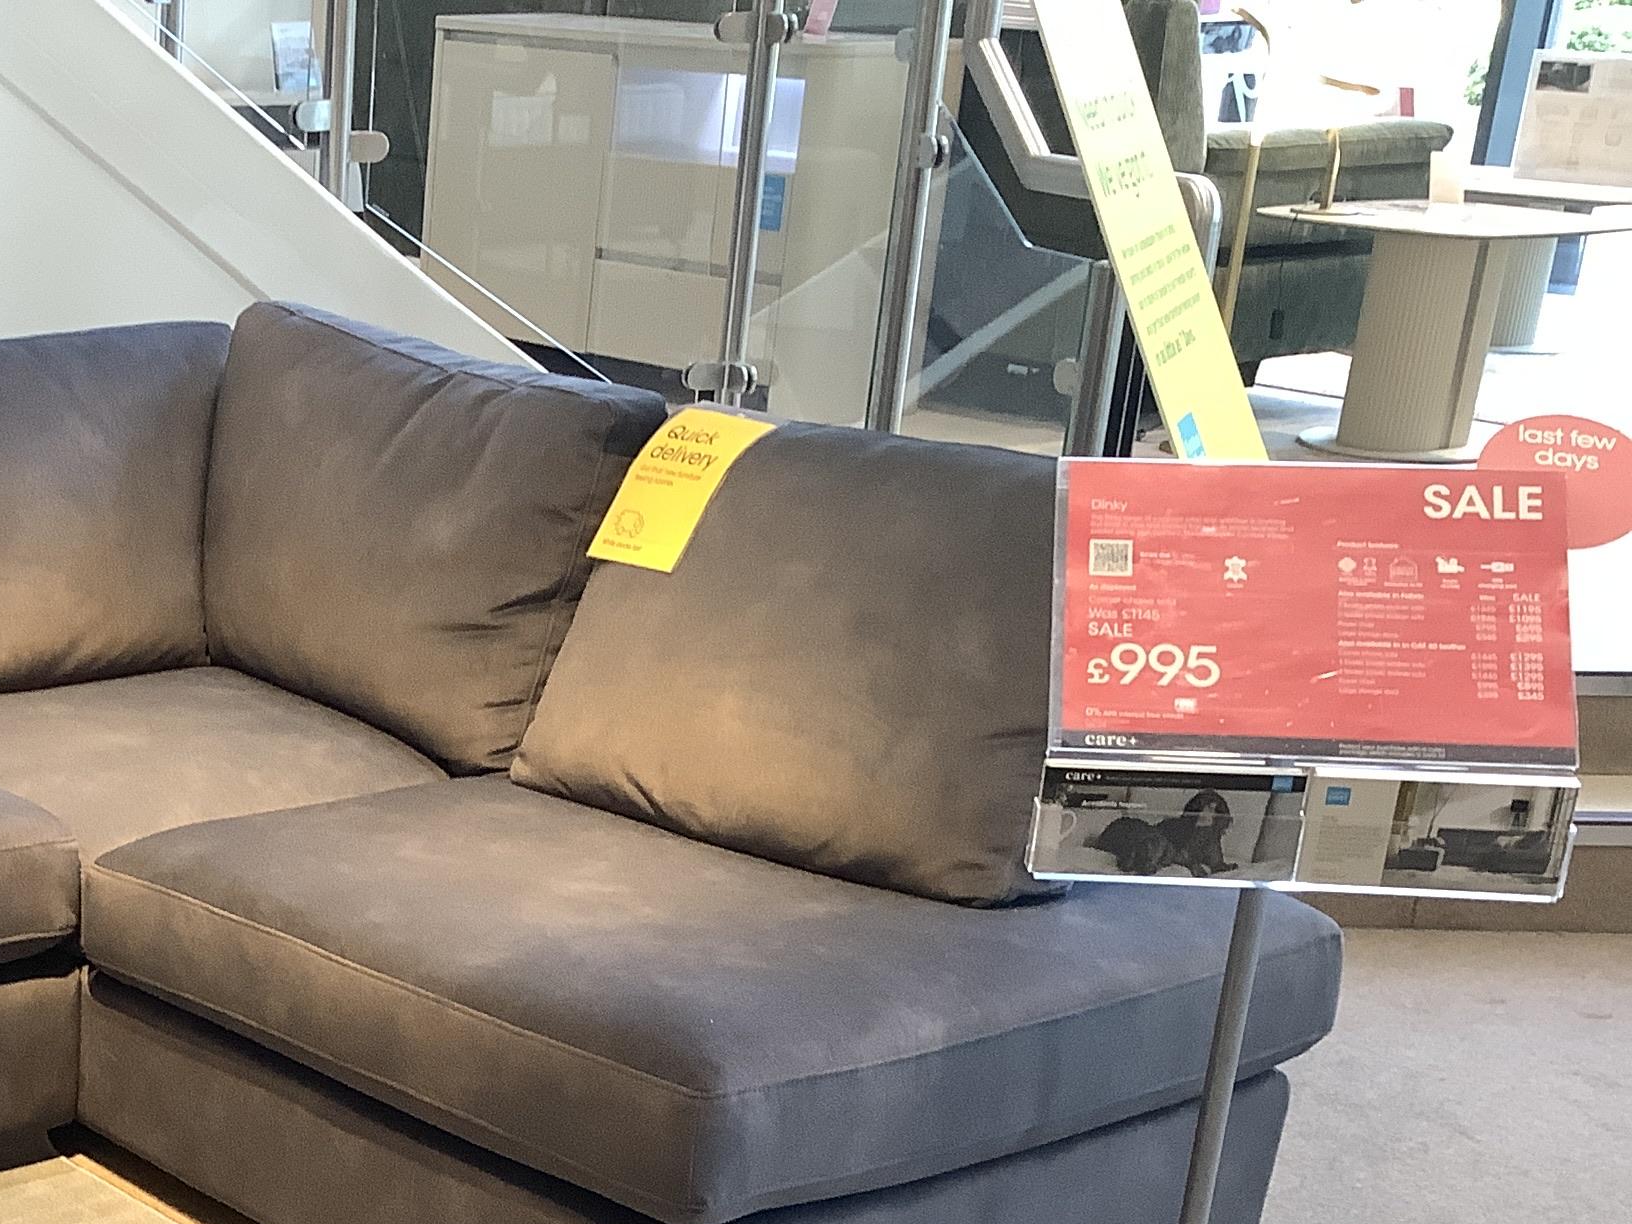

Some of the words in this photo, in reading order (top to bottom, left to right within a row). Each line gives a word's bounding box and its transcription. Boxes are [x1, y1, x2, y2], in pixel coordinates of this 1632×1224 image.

[667, 424, 720, 446] Quick
[1518, 424, 1564, 445] last
[1569, 429, 1617, 451] few
[650, 443, 718, 471] delivery
[1534, 447, 1600, 472] days
[1091, 498, 1128, 513] Dinky
[1423, 484, 1543, 520] SALE
[1512, 592, 1539, 602] SALE
[1088, 608, 1118, 619] Was
[1088, 621, 1133, 637] SALE
[1086, 642, 1221, 687] £995
[1085, 734, 1137, 746] care+
